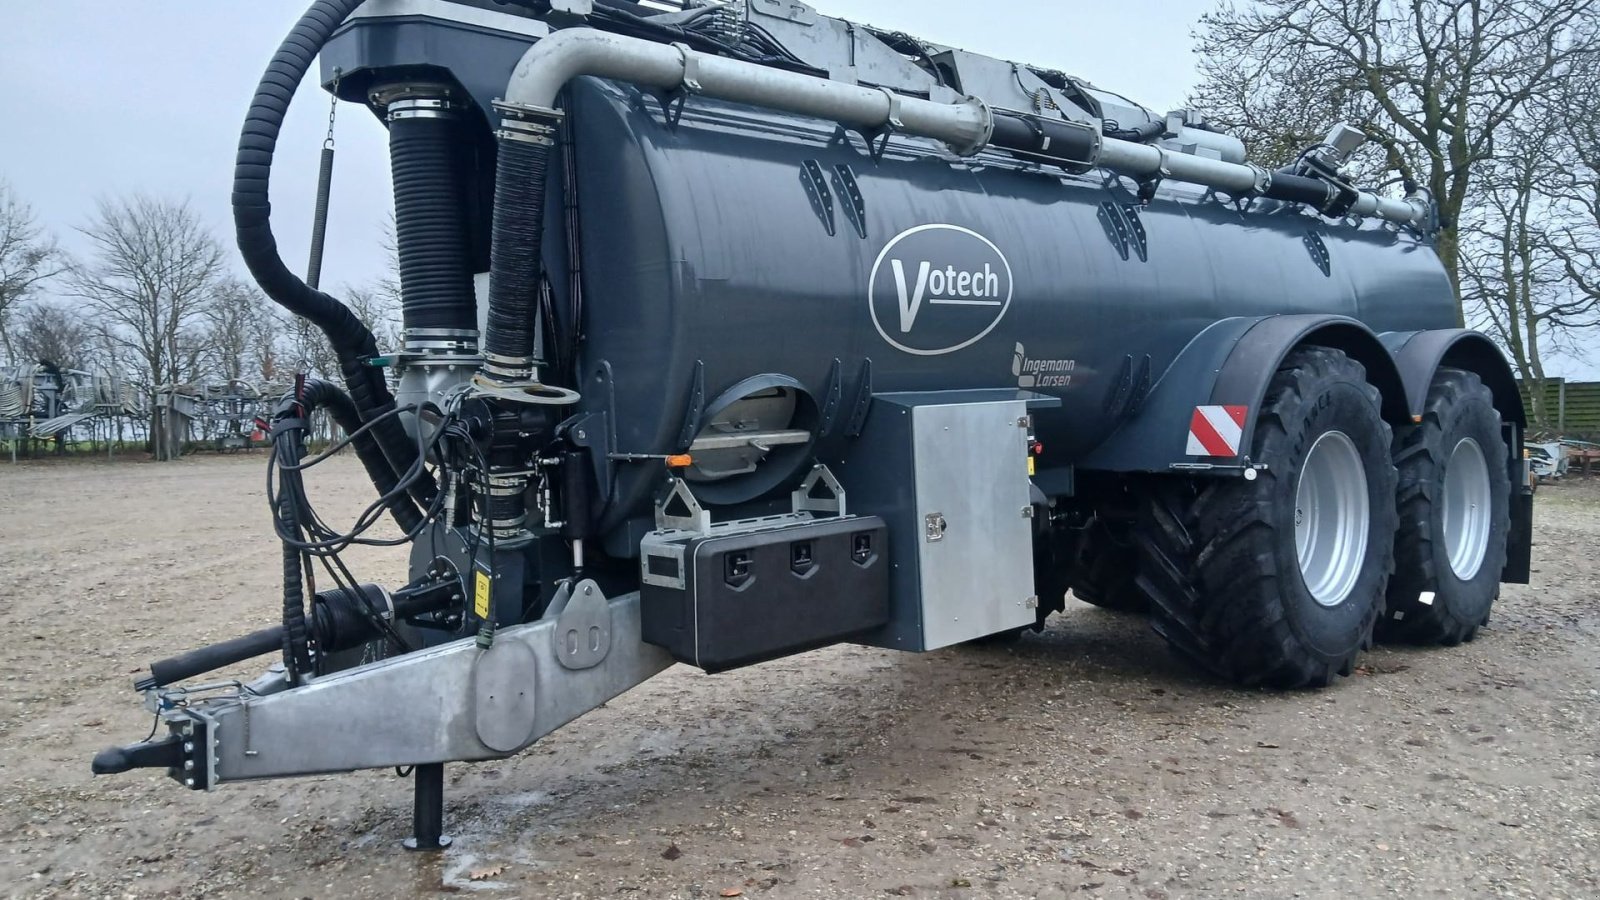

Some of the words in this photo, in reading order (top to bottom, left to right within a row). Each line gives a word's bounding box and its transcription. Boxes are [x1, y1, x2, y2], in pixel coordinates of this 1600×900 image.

[891, 259, 999, 333] Votech
[1023, 357, 1075, 375] Ingemann
[1035, 373, 1071, 387] Larsen
